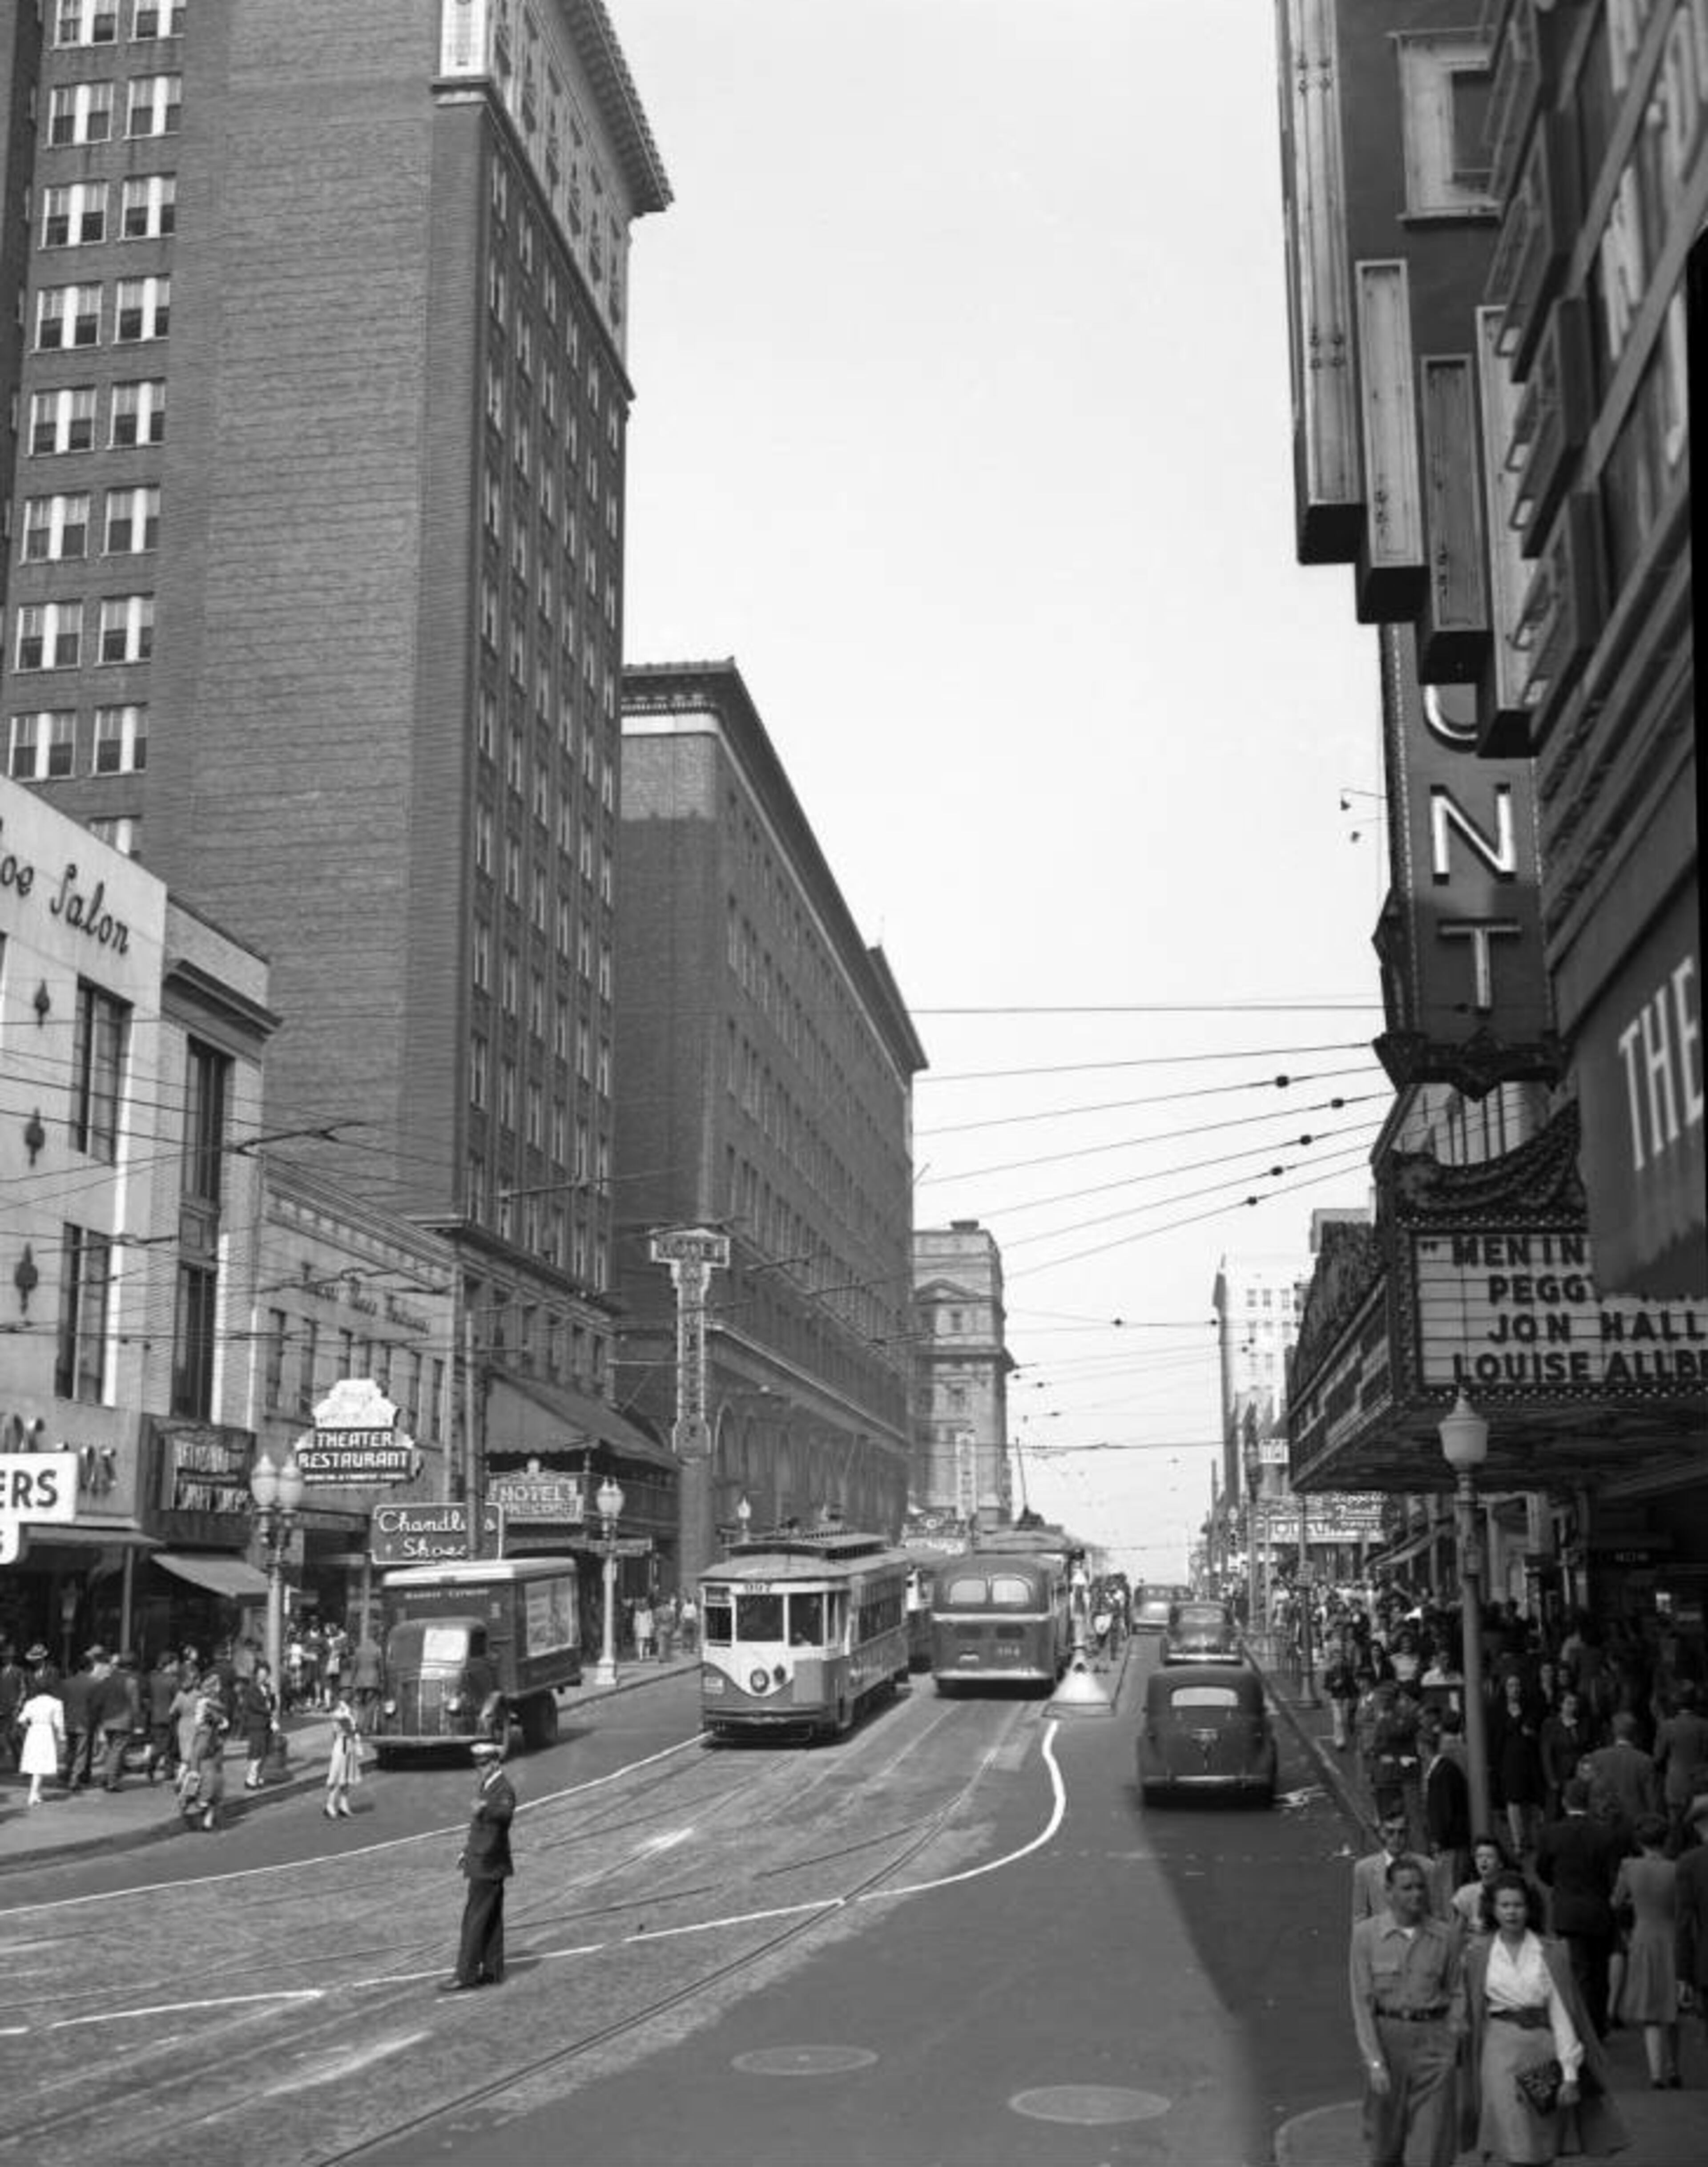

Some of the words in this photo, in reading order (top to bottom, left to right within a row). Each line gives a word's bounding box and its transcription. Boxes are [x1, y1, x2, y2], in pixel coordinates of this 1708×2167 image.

[50, 863, 129, 955] Salon
[1543, 1235, 1585, 1267] IN
[1487, 1274, 1594, 1304] PEGG
[1487, 1311, 1572, 1344] JON
[1601, 1310, 1706, 1342] HALL
[1453, 1351, 1591, 1383] LOUISE
[316, 1431, 392, 1448] THEATER
[298, 1452, 408, 1469] RESTAURANT
[500, 1485, 565, 1502] HOTEL
